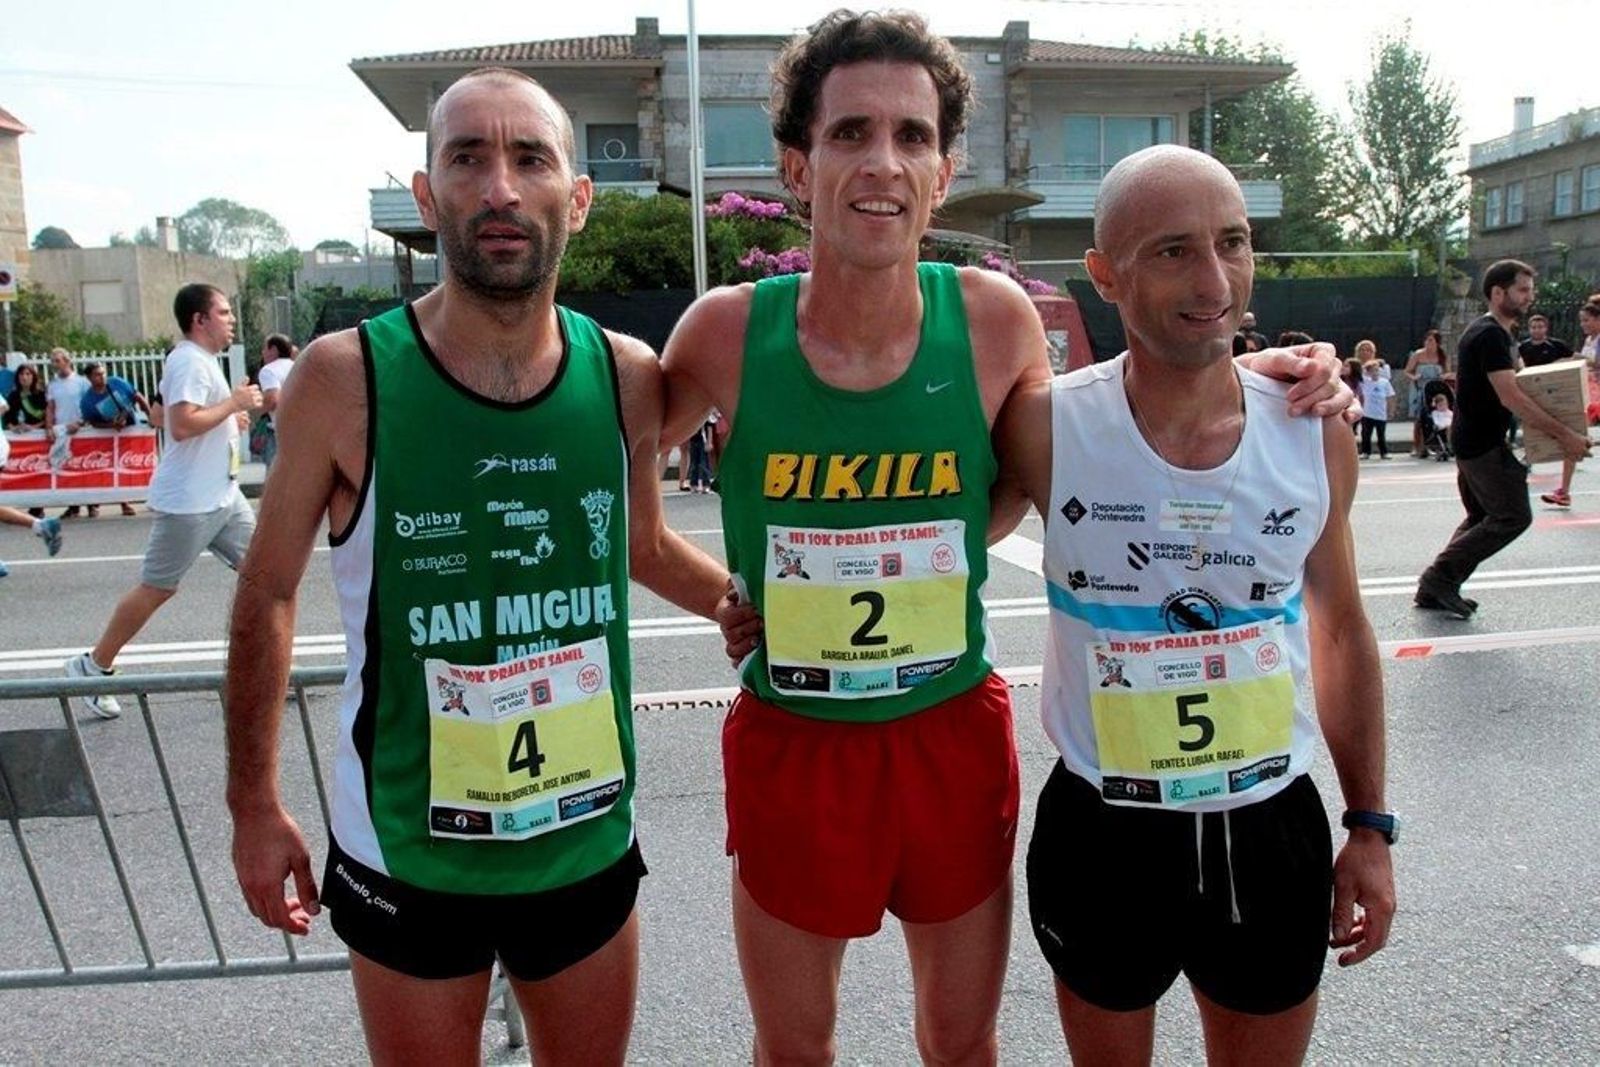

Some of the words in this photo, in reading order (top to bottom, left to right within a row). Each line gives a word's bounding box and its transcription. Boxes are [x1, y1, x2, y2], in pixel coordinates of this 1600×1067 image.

[511, 453, 557, 473] rasán
[763, 450, 963, 500] BIKILA
[1091, 502, 1145, 513] Deputación
[415, 512, 461, 527] dibay
[1091, 512, 1146, 522] Pontevedra
[789, 532, 805, 544] III
[808, 532, 832, 546] 10K
[835, 531, 877, 546] PRAIA
[879, 530, 897, 543] DE
[900, 526, 939, 541] SAMIL
[837, 559, 879, 569] CONCELLO
[1153, 552, 1192, 561] GALEGO
[841, 568, 853, 576] DE
[855, 567, 875, 576] VIGO
[1091, 582, 1139, 592] Pontevedra
[408, 600, 482, 647] SAN
[850, 590, 888, 646] 2
[1128, 641, 1152, 654] 10K
[1154, 635, 1199, 650] PRAIA
[1200, 633, 1221, 646] DE
[1223, 626, 1261, 644] SAMIL
[488, 663, 527, 682] PRAIA
[529, 656, 547, 671] DE
[548, 648, 584, 666] SAMIL
[1158, 661, 1202, 672] CONCELLO
[1163, 672, 1175, 680] DE
[1176, 671, 1197, 679] VIGO
[492, 688, 528, 704] CONCELLO
[498, 702, 508, 712] DE
[1176, 692, 1215, 752] 5
[508, 720, 545, 778] 4
[1151, 757, 1186, 769] FUENTES
[1216, 749, 1245, 761] RAFAEL
[560, 769, 591, 786] ANTONIO
